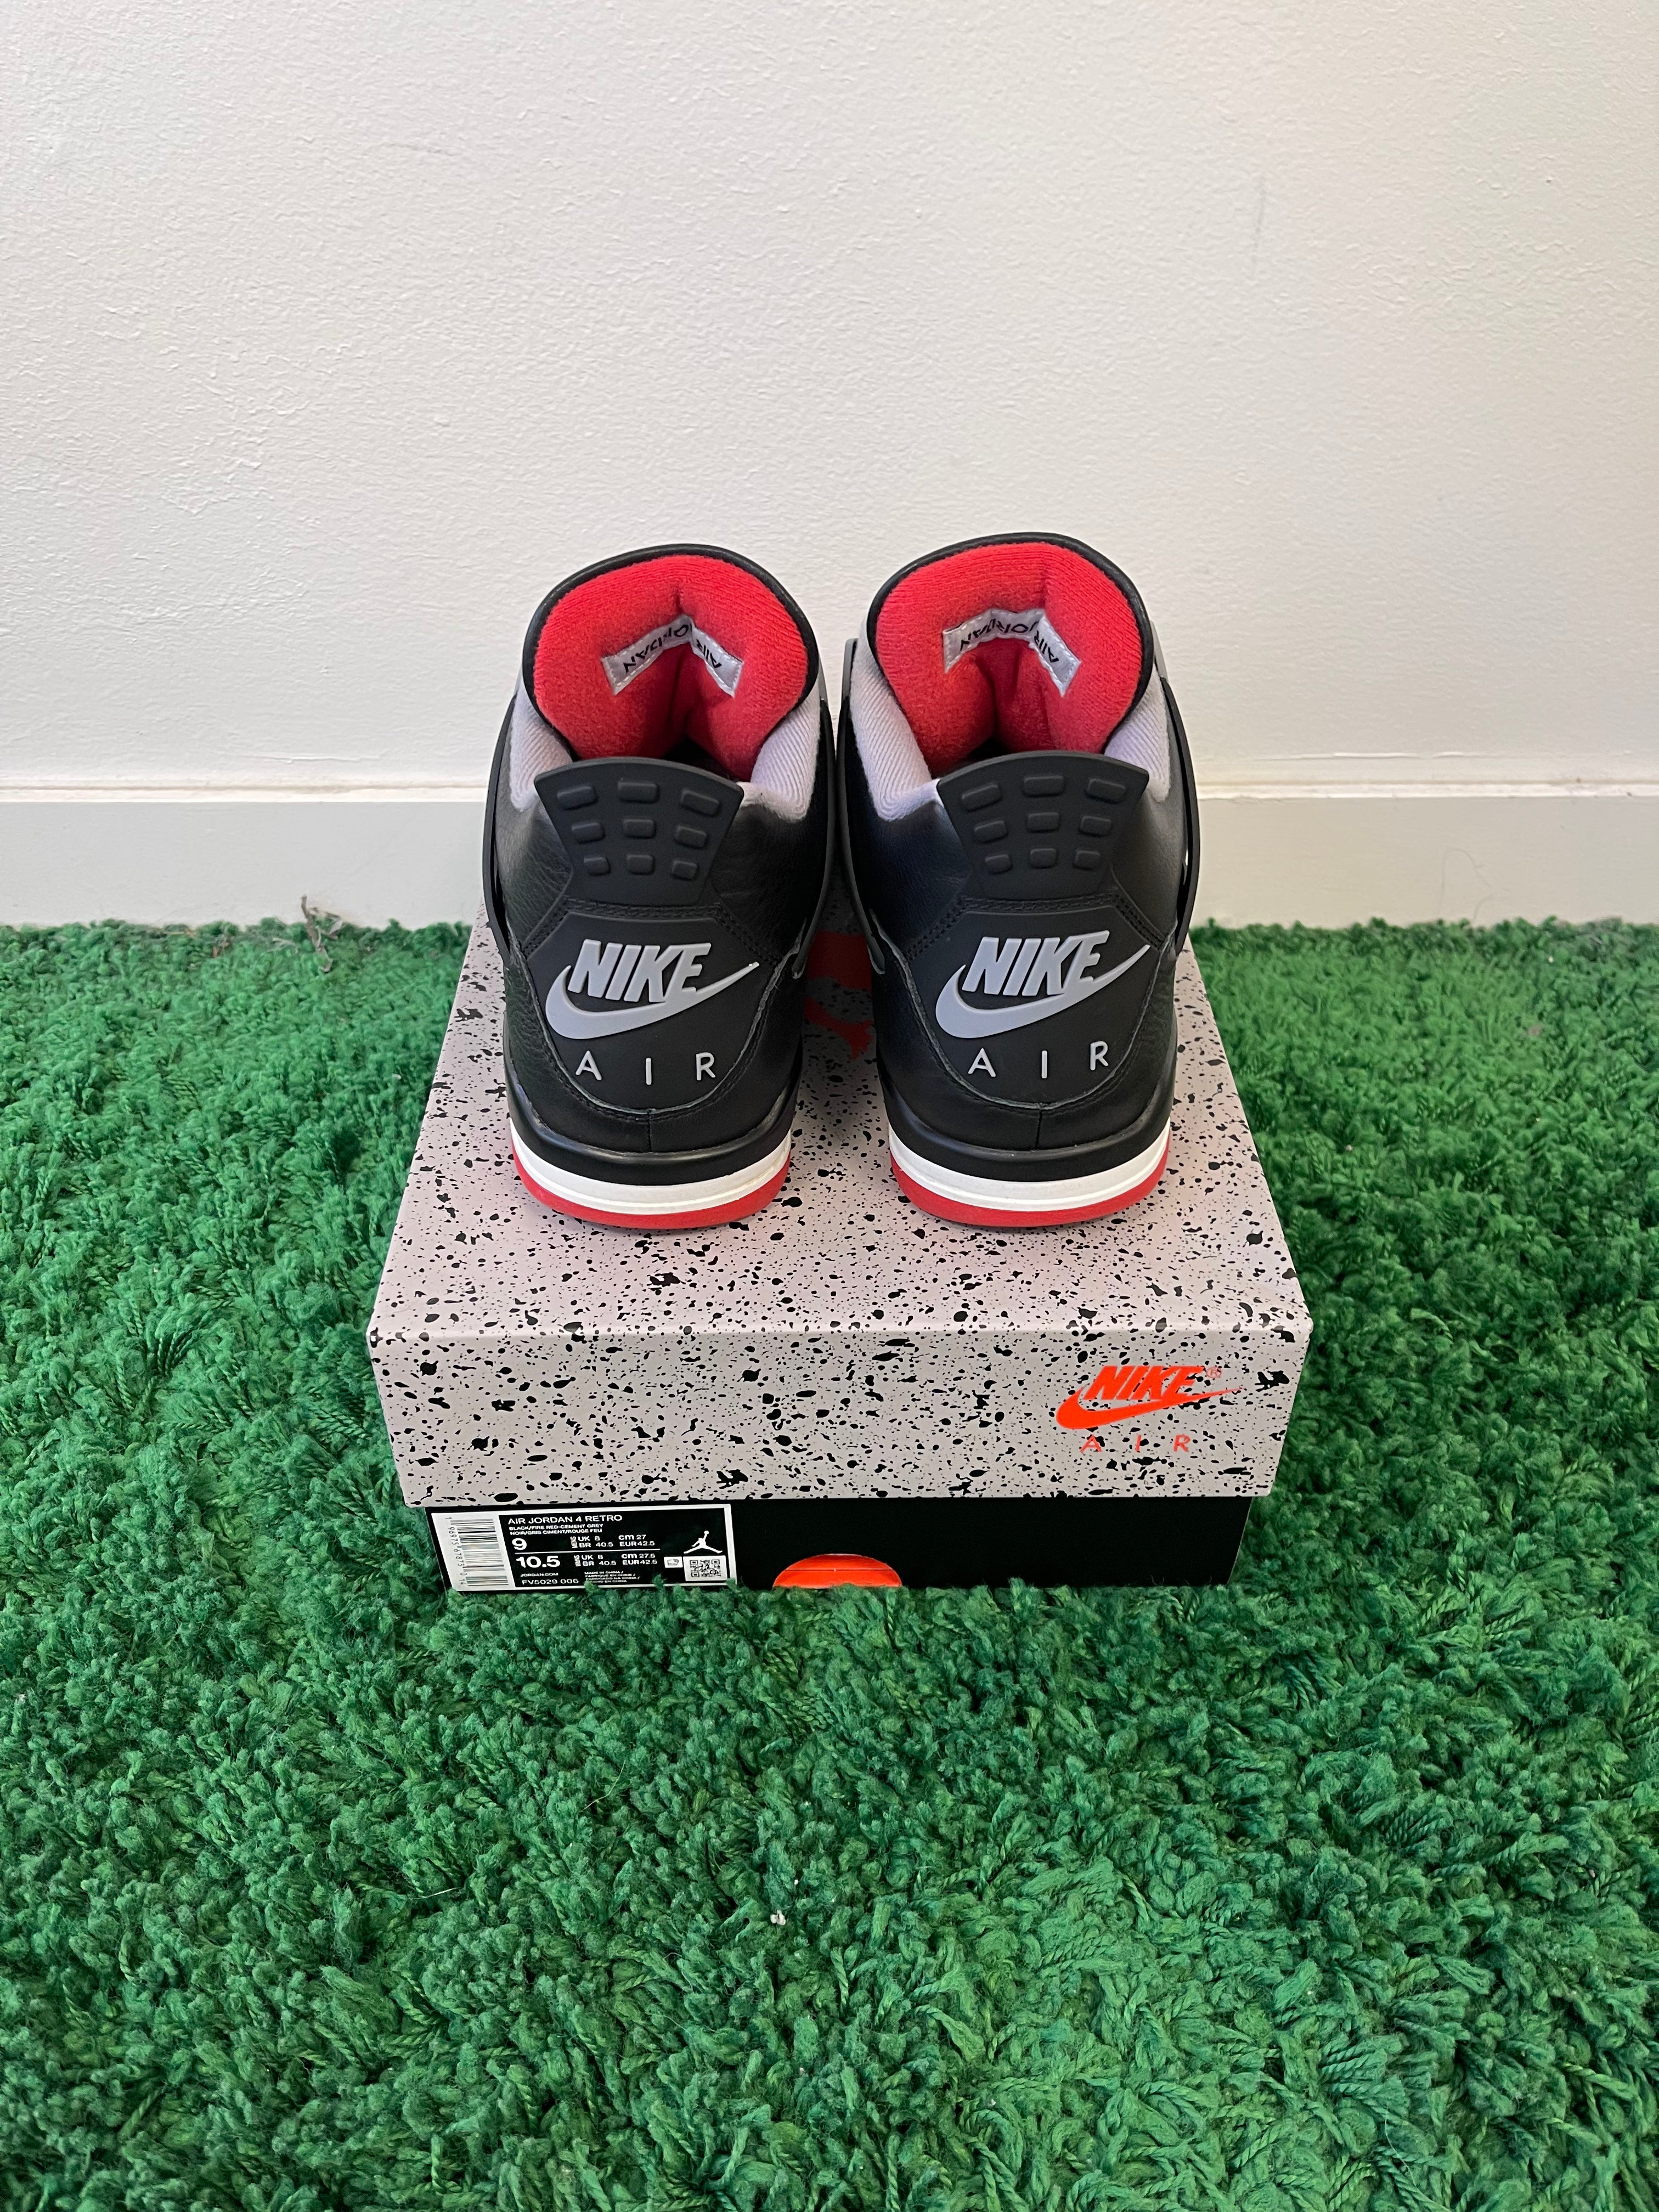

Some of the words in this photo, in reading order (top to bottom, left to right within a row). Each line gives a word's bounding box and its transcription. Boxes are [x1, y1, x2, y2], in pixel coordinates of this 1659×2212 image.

[696, 639, 722, 669] AIR
[1034, 630, 1059, 663] AIR
[567, 939, 712, 1003] NIKE
[962, 930, 1110, 996] NIKE
[575, 1050, 716, 1085] AIR
[968, 1041, 1109, 1079] AIR
[1083, 1365, 1204, 1401] NIKE
[1080, 1434, 1192, 1453] AIR
[511, 1538, 527, 1550] 9
[516, 1556, 561, 1568] 10.5
